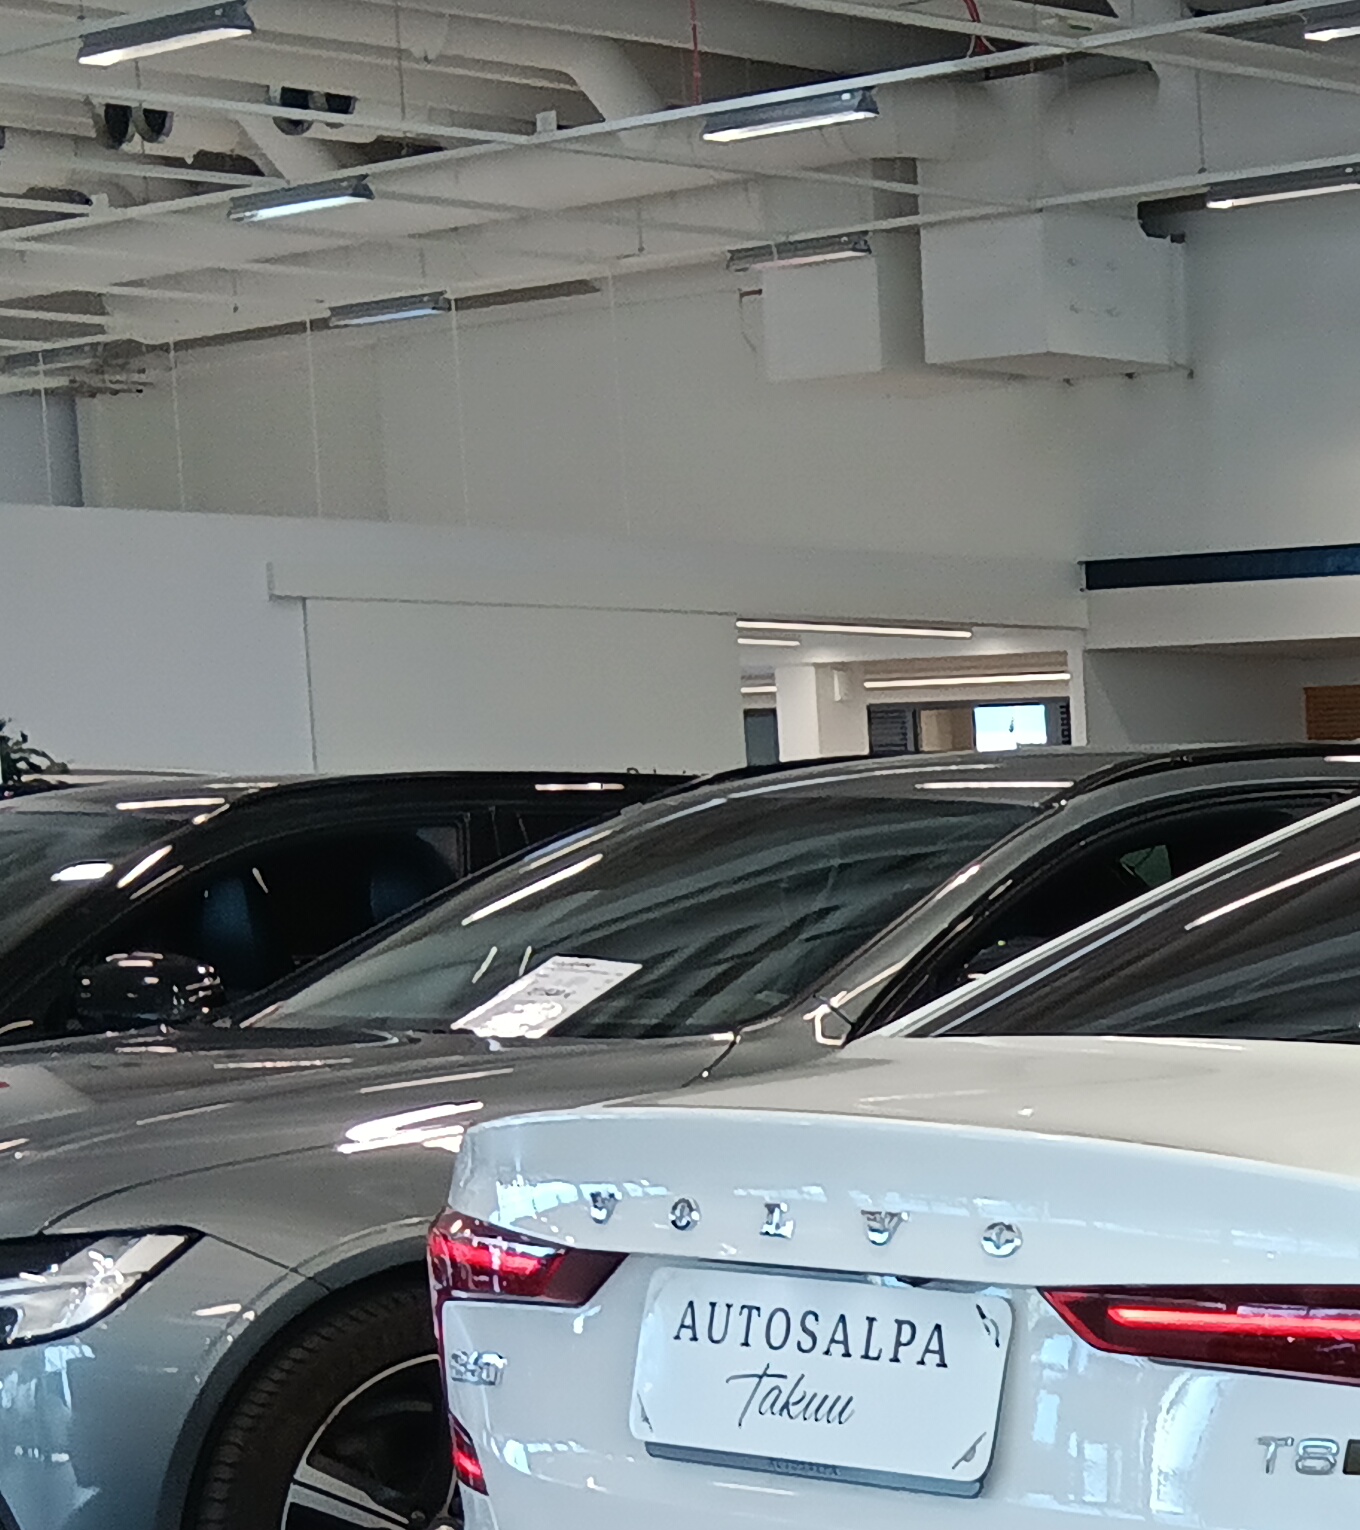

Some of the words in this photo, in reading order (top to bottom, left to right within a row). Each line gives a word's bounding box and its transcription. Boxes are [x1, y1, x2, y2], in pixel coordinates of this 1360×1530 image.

[589, 1191, 1023, 1258] VOLVO
[674, 1300, 949, 1368] AUTOSALPA
[726, 1363, 855, 1429] Takuu
[1257, 1436, 1340, 1476] T8
